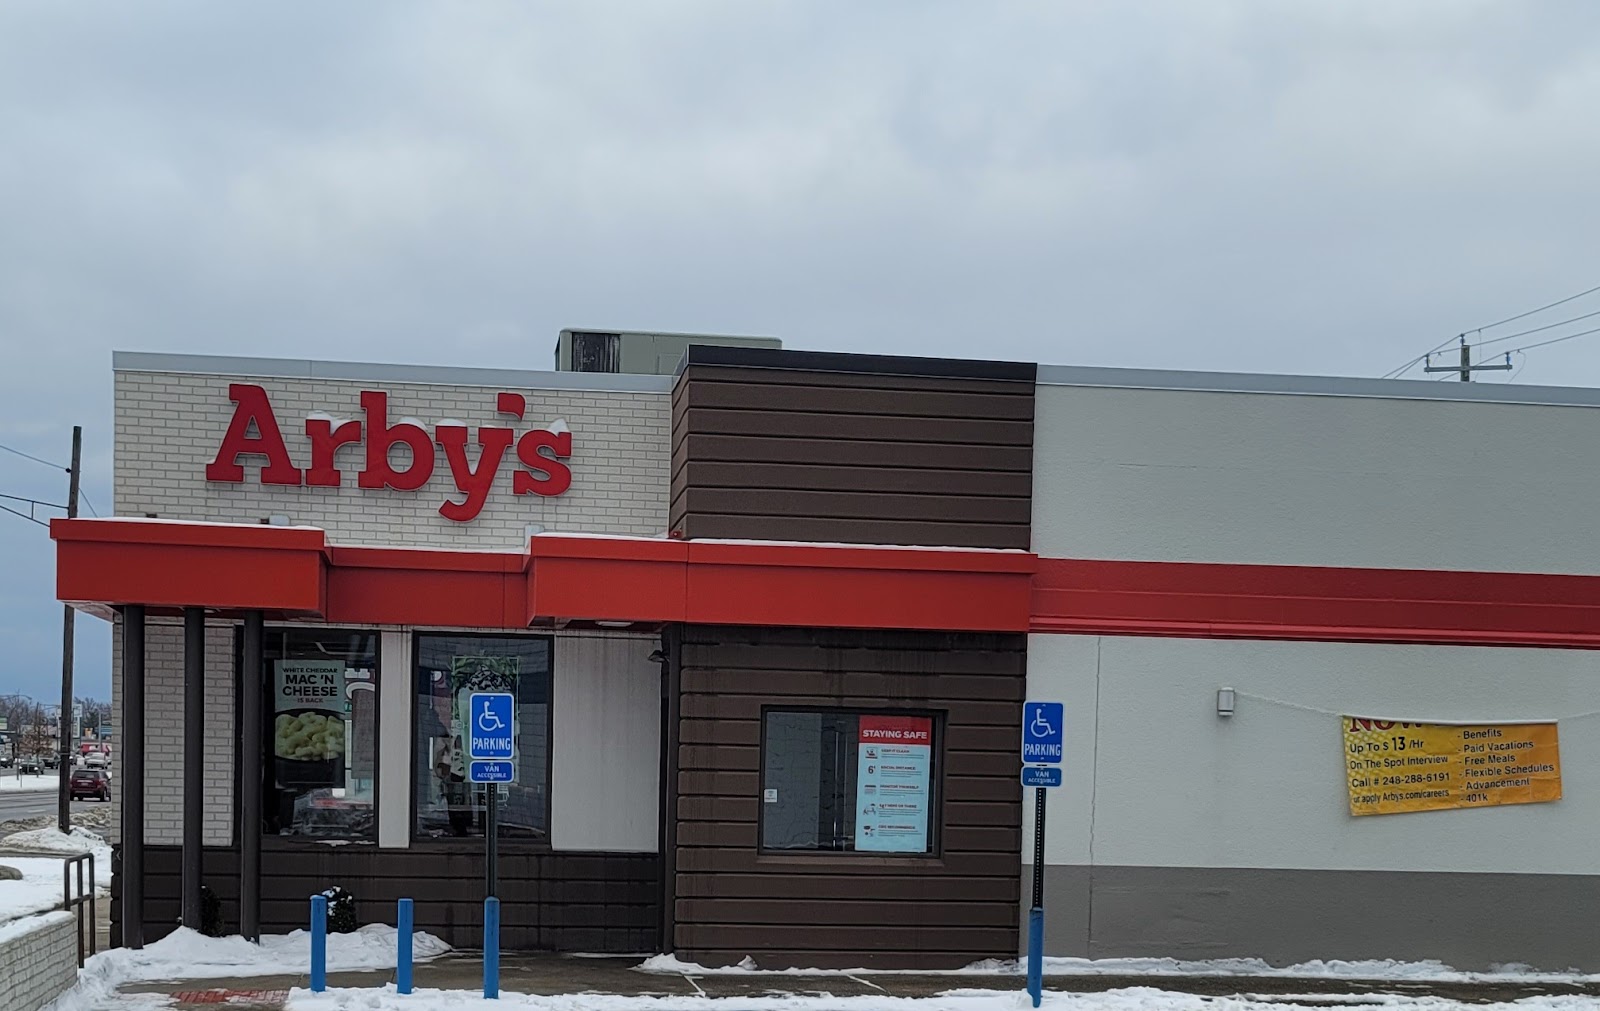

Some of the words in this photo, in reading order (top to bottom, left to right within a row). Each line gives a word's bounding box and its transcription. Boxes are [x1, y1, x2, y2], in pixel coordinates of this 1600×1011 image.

[206, 383, 572, 522] Arby's
[285, 675, 317, 685] MAC
[320, 675, 334, 685] 'N
[282, 686, 338, 697] CHEESE
[862, 729, 902, 739] STAYING
[903, 731, 928, 740] SAFE
[1463, 729, 1502, 739] Benefits
[472, 737, 511, 750] PARKING
[1024, 743, 1061, 756] PARKING
[1350, 743, 1364, 754] Up
[1366, 742, 1380, 752] To
[1383, 741, 1389, 751] $
[1391, 736, 1406, 751] 13
[1409, 739, 1424, 749] /Hr
[1463, 743, 1484, 753] Paid
[1487, 740, 1534, 752] Vacations
[1350, 760, 1362, 770] On
[1365, 759, 1382, 769] The
[1384, 758, 1405, 768] Spot
[1407, 755, 1448, 766] Interview
[1464, 756, 1485, 766] Free
[1487, 753, 1516, 764] Meals
[1035, 770, 1049, 778] VAN
[1464, 767, 1502, 777] Flexible
[1504, 764, 1555, 775] Schedules
[1351, 778, 1371, 788] Call
[1382, 772, 1450, 785] 248-288-6191
[1466, 777, 1530, 790] Advancement
[1361, 793, 1381, 804] apply
[1465, 793, 1488, 802] 401k
